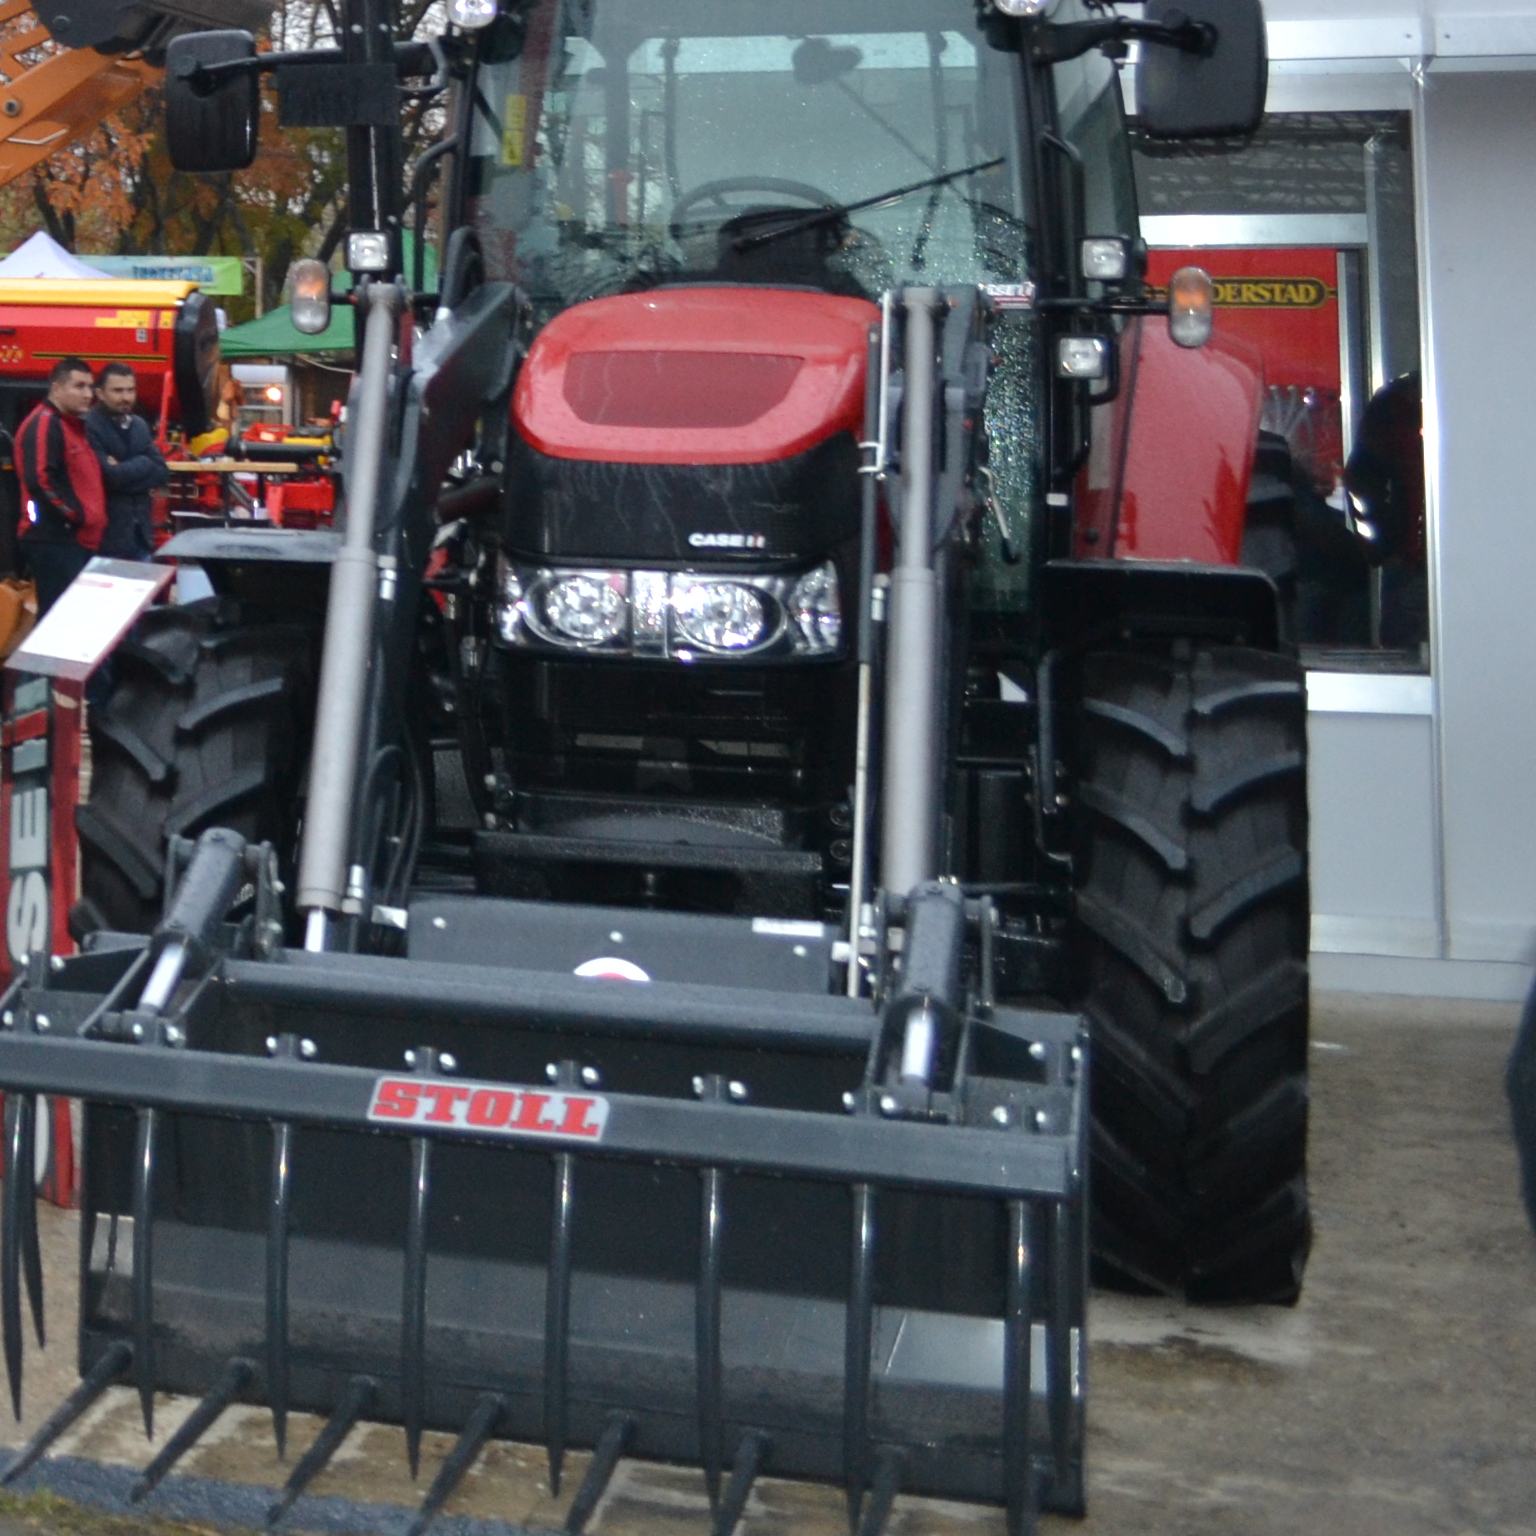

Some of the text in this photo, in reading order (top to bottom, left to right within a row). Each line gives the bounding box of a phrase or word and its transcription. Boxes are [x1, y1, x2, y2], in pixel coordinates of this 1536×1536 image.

[1212, 283, 1317, 304] DERSTAD
[688, 531, 744, 548] CASE
[373, 1079, 600, 1137] STOLL
